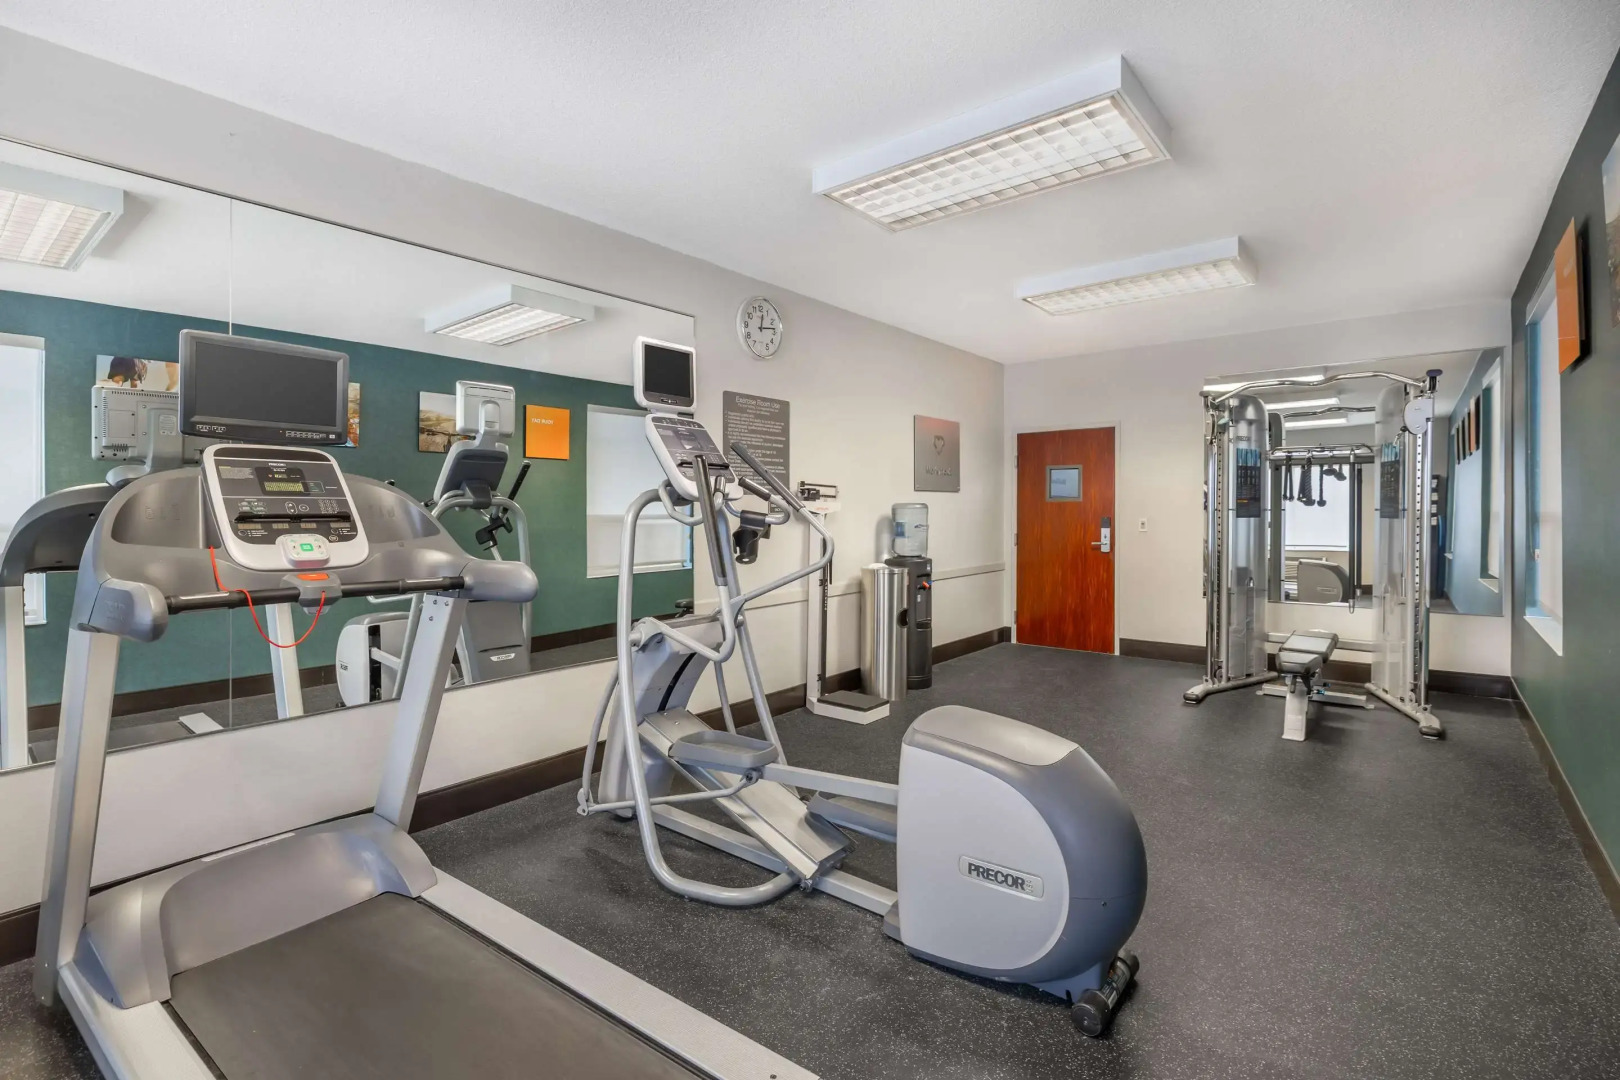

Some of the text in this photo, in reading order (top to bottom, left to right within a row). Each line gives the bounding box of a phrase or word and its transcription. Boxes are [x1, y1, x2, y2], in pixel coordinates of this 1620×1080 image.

[752, 306, 757, 314] 11
[758, 305, 764, 313] 12
[747, 312, 753, 320] 10
[744, 321, 749, 329] 9
[770, 318, 775, 326] 2
[765, 343, 770, 351] 5
[735, 395, 757, 406] Exercise
[757, 399, 771, 407] Room
[967, 862, 1026, 891] PRECOR
